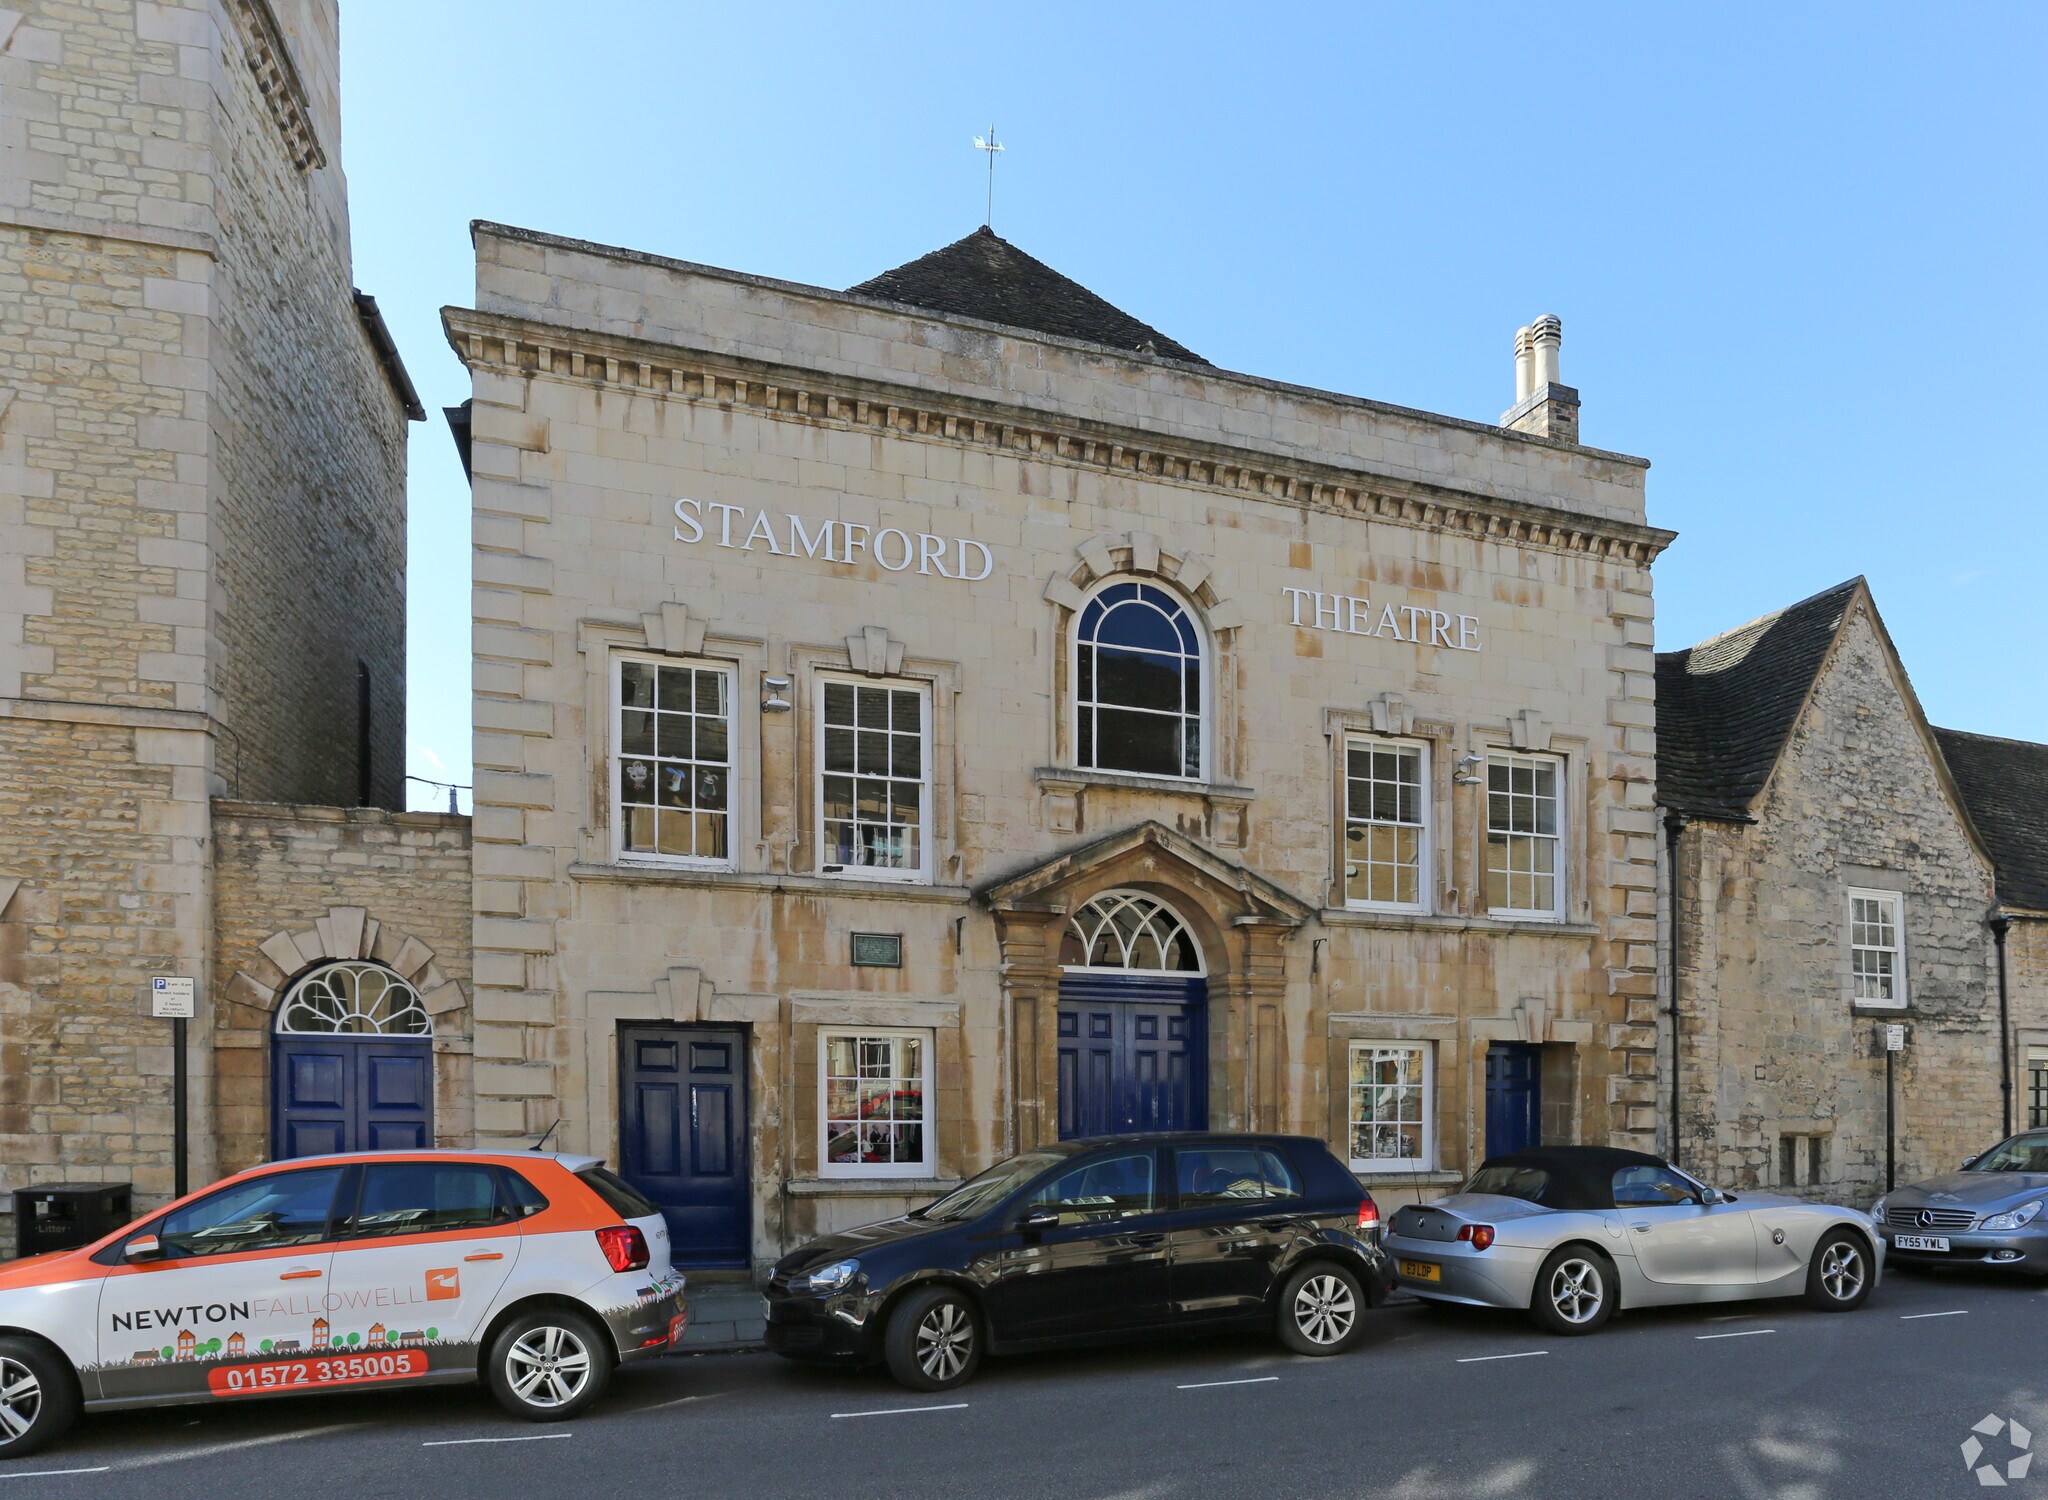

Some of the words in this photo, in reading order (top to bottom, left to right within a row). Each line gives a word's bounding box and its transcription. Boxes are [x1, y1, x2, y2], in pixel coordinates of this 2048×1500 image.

[673, 498, 994, 582] STAMFORD
[1282, 586, 1482, 652] THEATRE
[156, 979, 165, 989] P
[38, 1224, 66, 1233] Litter
[1897, 1236, 1921, 1247] FY55
[1922, 1238, 1944, 1249] YWL
[1406, 1263, 1416, 1276] E3
[1416, 1264, 1432, 1278] LDP
[227, 1363, 310, 1391] 01572
[316, 1354, 412, 1382] 335005
